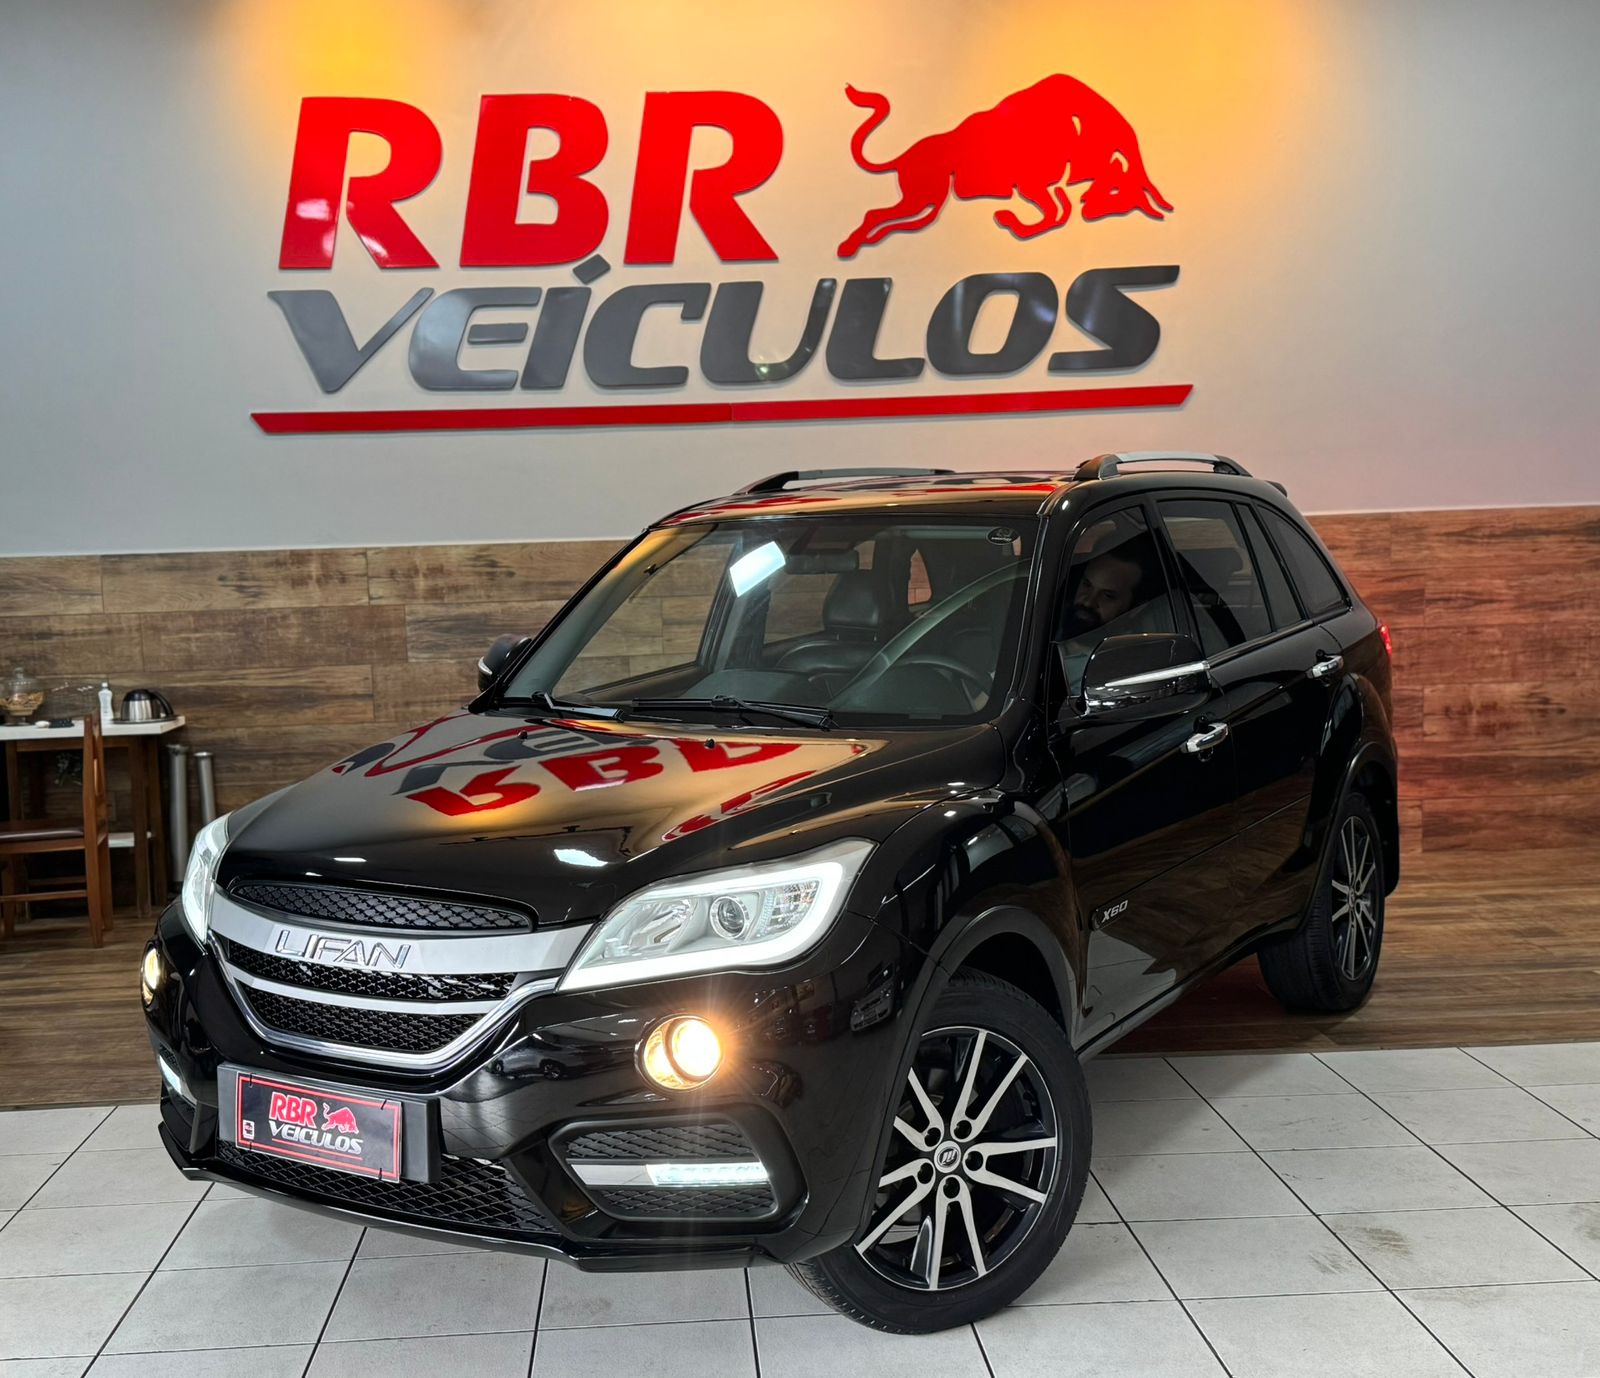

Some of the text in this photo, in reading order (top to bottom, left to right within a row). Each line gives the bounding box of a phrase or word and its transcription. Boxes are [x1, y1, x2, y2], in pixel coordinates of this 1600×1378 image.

[279, 90, 785, 270] RBR
[268, 254, 1181, 394] VEÍCULOS
[1101, 899, 1129, 923] X60
[275, 929, 411, 969] LIFAN
[268, 1091, 318, 1129] RBR
